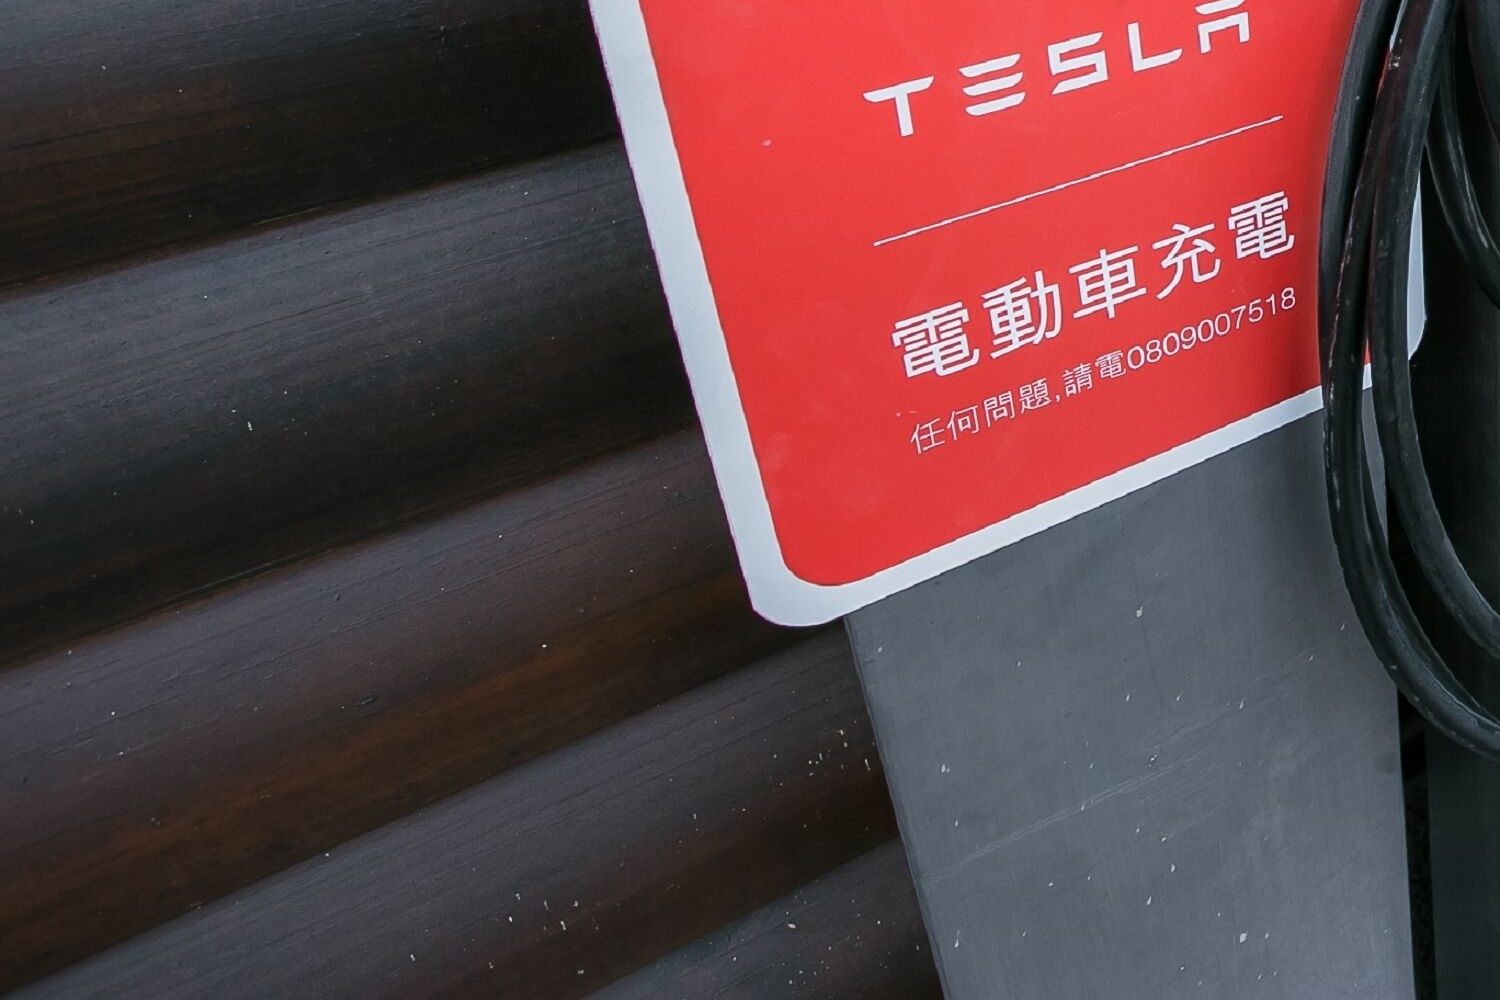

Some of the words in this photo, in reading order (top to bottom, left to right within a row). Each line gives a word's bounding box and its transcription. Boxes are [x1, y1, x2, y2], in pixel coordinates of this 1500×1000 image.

[891, 190, 1296, 378] 電動車充電
